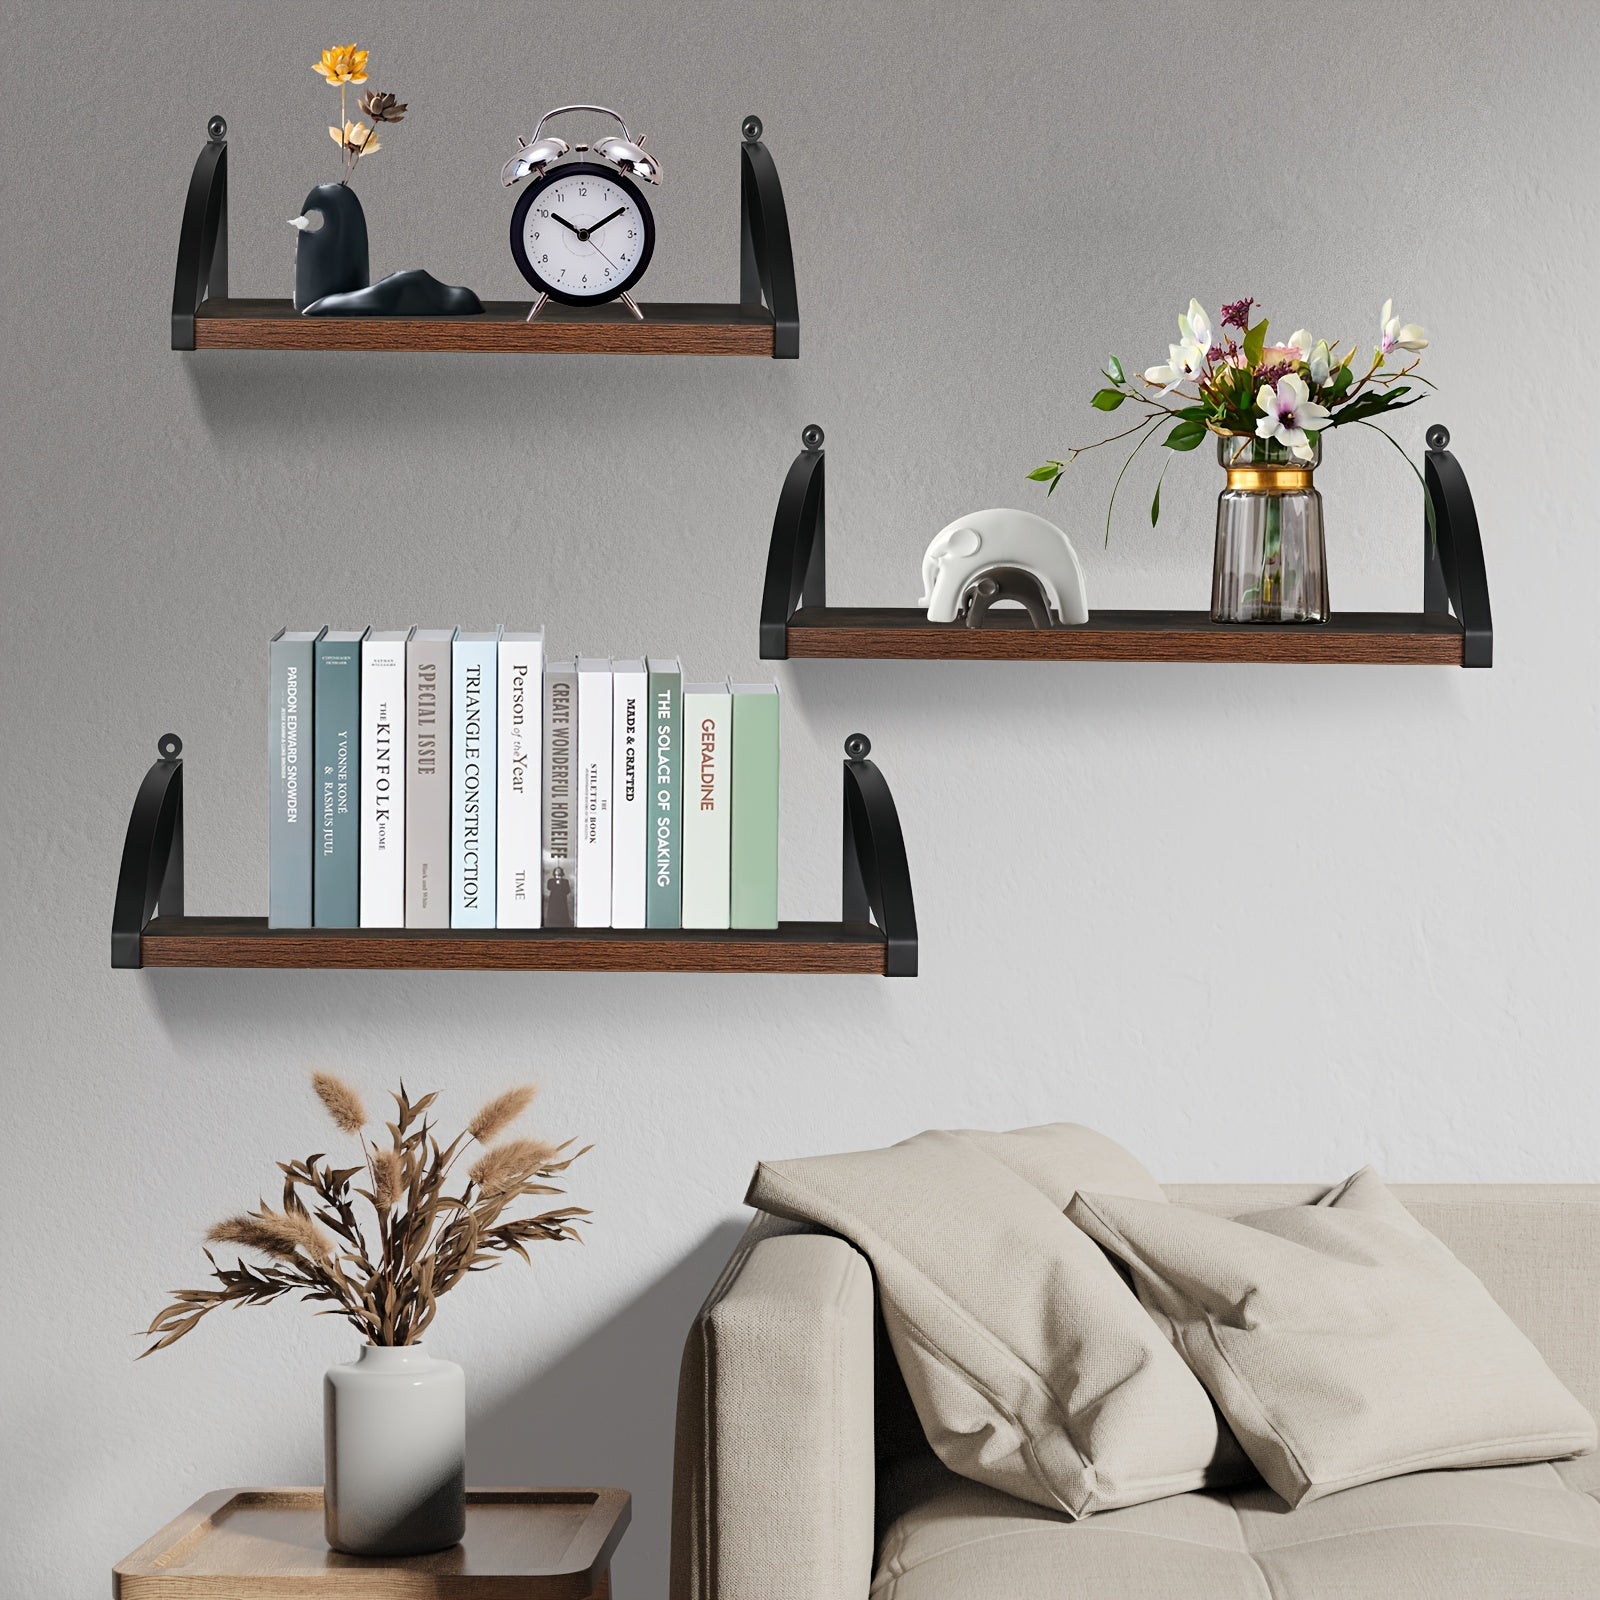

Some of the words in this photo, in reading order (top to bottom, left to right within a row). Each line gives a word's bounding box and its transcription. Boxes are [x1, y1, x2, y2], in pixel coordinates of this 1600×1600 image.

[557, 194, 565, 203] 11
[578, 188, 587, 197] 12
[540, 209, 549, 218] 10
[534, 231, 540, 240] 9
[627, 230, 633, 239] 3
[542, 254, 549, 263] 8
[620, 253, 626, 261] 4
[560, 269, 566, 277] 7
[581, 274, 588, 283] 6
[604, 268, 610, 277] 5
[287, 667, 297, 713] PARDON
[418, 664, 436, 726] SPECIAL
[513, 665, 528, 725] Person
[552, 683, 570, 724] CREATE
[657, 690, 671, 719] THE
[379, 702, 387, 721] THE
[465, 664, 481, 759] TRIANGLE
[626, 699, 636, 734] MADE
[287, 716, 297, 764] EDWARD
[511, 728, 522, 738] of
[626, 736, 635, 745] &
[417, 734, 436, 775] ISSUE
[513, 741, 522, 757] the
[551, 727, 570, 798] WONDERFUL
[657, 725, 671, 784] SOLACE
[323, 766, 334, 775] &
[376, 723, 390, 822] KINFOLK
[512, 754, 528, 794] Year
[625, 748, 636, 802] CRAFTED
[700, 718, 716, 811] GERALDINE
[287, 765, 297, 823] SNOWDEN
[323, 782, 334, 827] RASMUS
[657, 790, 671, 811] OF
[322, 828, 334, 856] JUUL
[378, 823, 386, 850] HOME
[464, 763, 480, 909] CONSTRUCTION
[550, 802, 569, 859] HOMELIFE
[589, 817, 597, 844] BOOK
[656, 817, 671, 888] SOAKING
[515, 870, 526, 900] TIME
